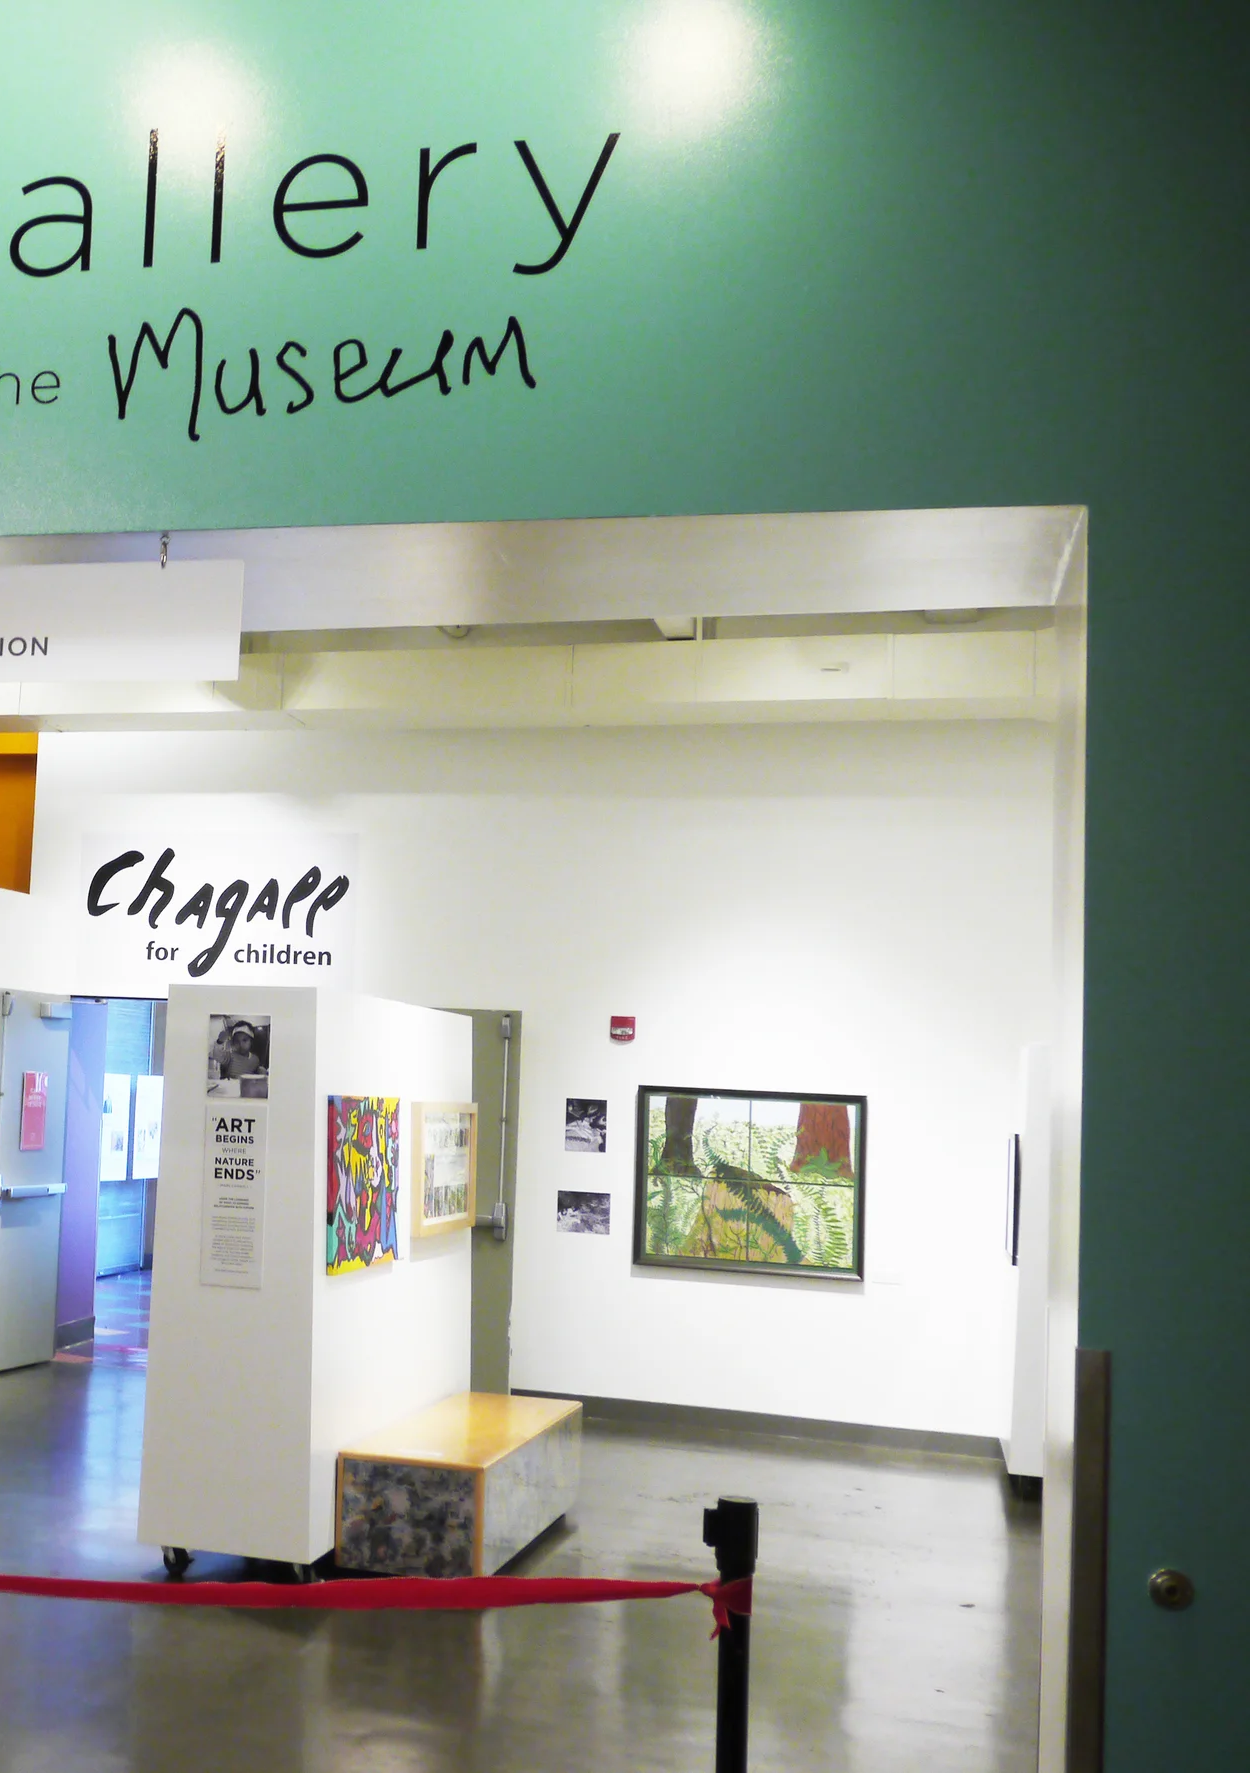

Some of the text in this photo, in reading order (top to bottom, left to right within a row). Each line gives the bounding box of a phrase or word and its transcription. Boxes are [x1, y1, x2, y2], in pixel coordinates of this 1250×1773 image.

[146, 941, 332, 966] for children
[215, 1134, 255, 1144] BEGINS
[221, 1147, 247, 1155] WHERE
[214, 1156, 255, 1167] NATURE
